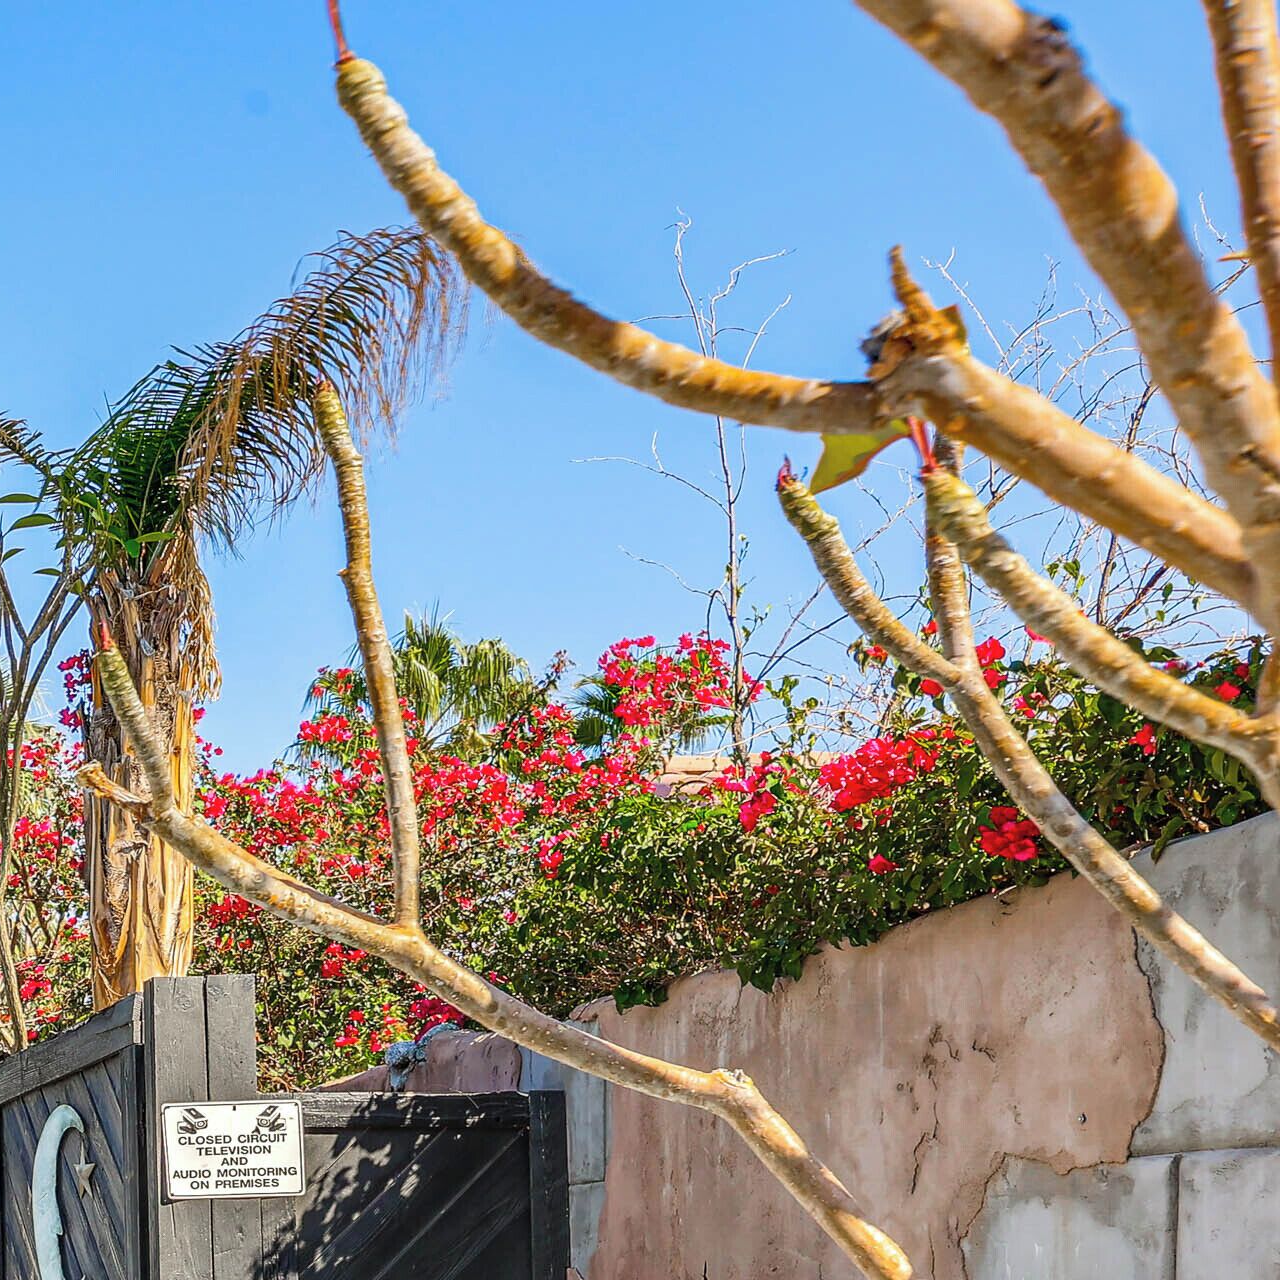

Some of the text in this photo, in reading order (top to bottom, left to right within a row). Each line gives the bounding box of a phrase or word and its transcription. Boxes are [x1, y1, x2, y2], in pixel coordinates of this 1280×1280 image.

[178, 1133, 287, 1145] CLOSED CIRCUIT
[196, 1145, 271, 1156] TELEVISION
[221, 1157, 248, 1166] AND
[173, 1167, 297, 1179] AUDIO MONITORING
[190, 1179, 279, 1189] ON PREMISES
